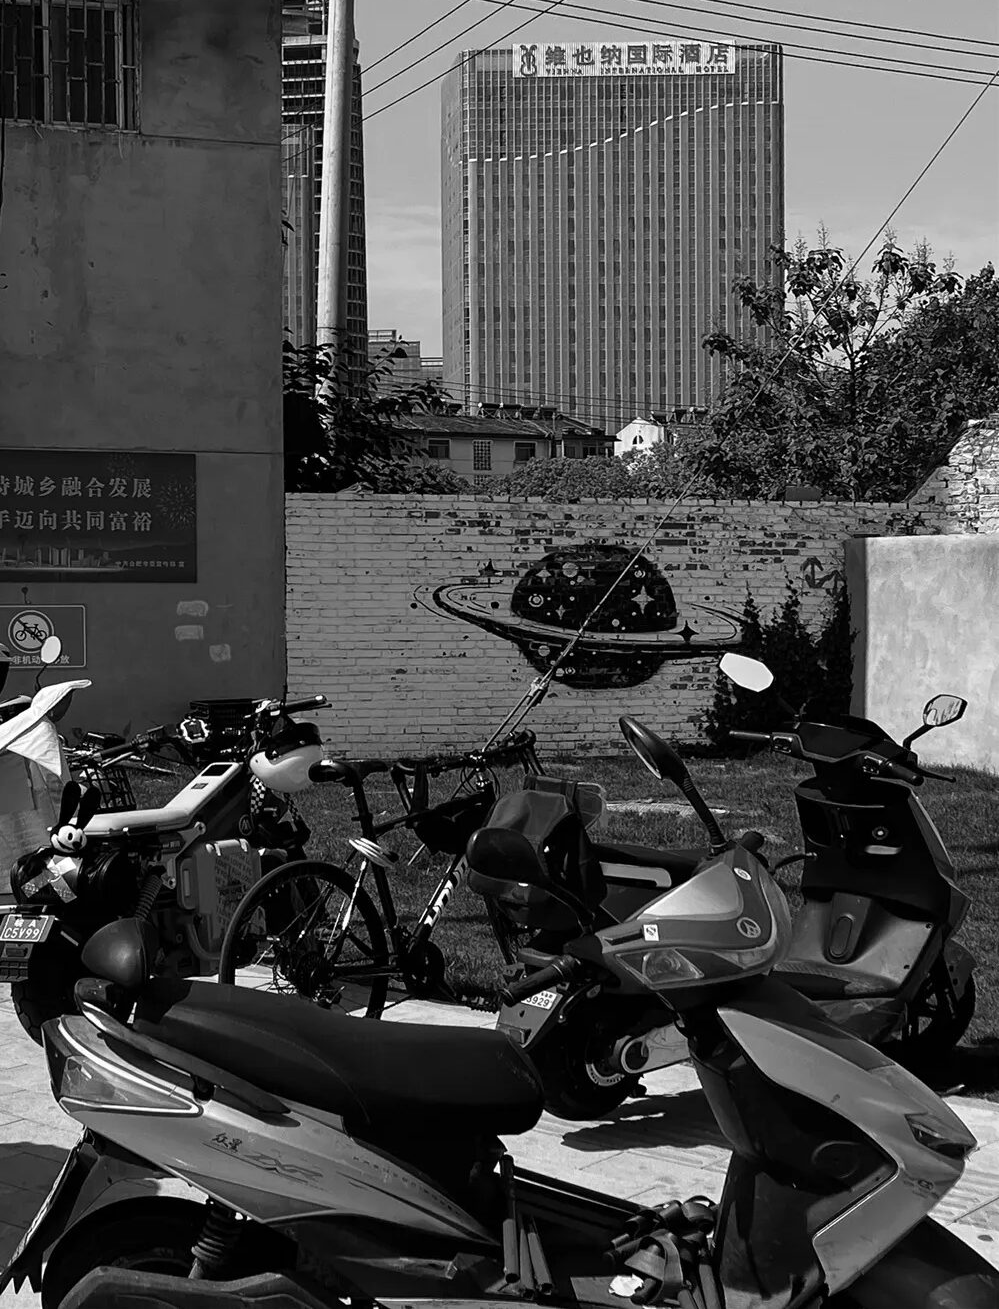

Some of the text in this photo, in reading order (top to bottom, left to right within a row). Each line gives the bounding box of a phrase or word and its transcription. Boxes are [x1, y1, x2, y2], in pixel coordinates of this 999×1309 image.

[545, 43, 731, 67] 维也纳国际酒店
[545, 65, 730, 76] VIENNA INTERNATIONAL HOTEL
